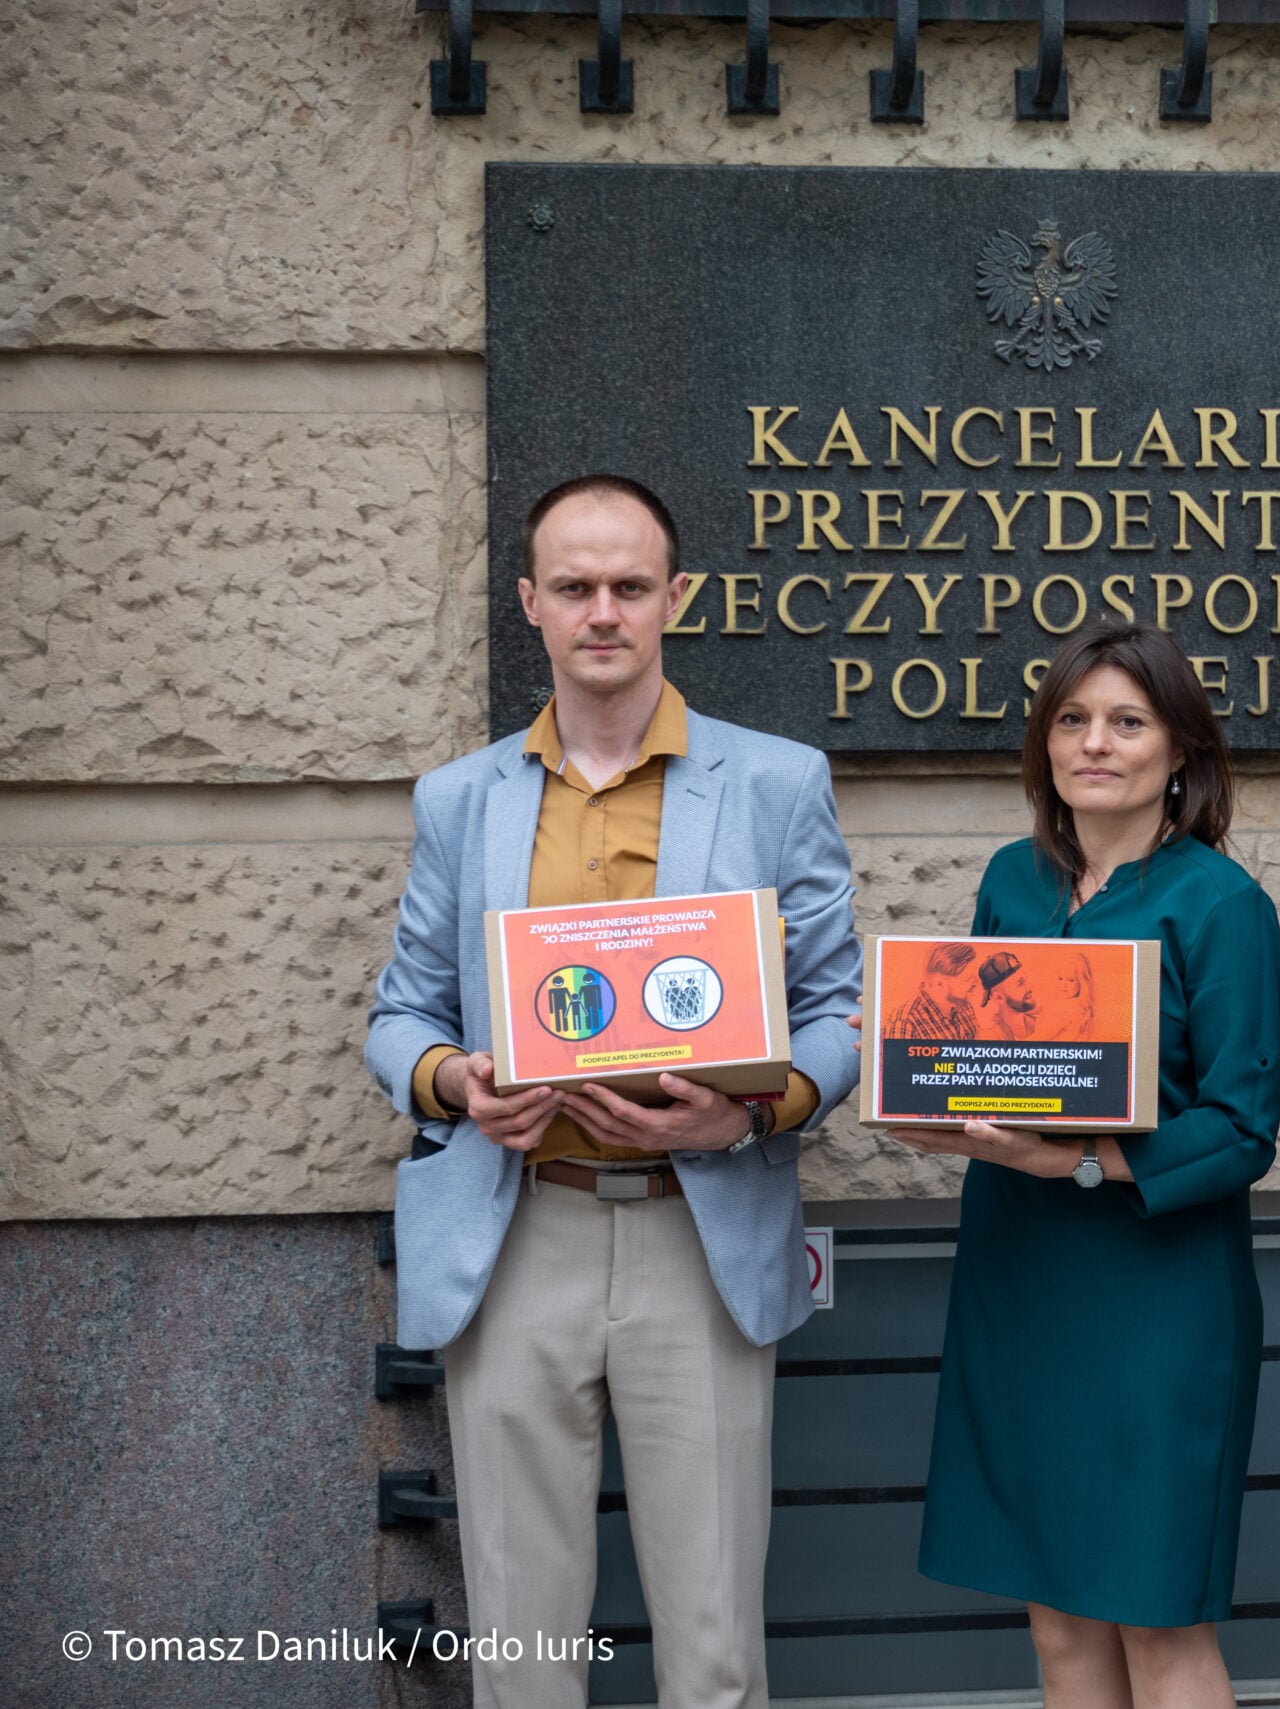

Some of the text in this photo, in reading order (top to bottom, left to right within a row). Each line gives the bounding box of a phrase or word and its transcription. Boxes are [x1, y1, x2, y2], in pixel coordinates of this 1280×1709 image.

[829, 656, 1273, 719] POLSEJ
[530, 910, 716, 934] ZWIĄZKI PARTNERSKIE PROWADZĄ
[560, 929, 629, 942] ZNISZCZENIA
[631, 922, 706, 937] MAŁŻEŃSTWA
[595, 939, 653, 951] I RODZINY!
[641, 1050, 685, 1058] PREZYDENTA!
[908, 1046, 1102, 1060] STOP ZWIĄZKOM PARTNERSKIM!
[934, 1063, 1076, 1075] NIE DLA ADOPCJI DZIECI
[912, 1075, 1098, 1088] PRZEZ PARY HOMOSEKSUALNE!
